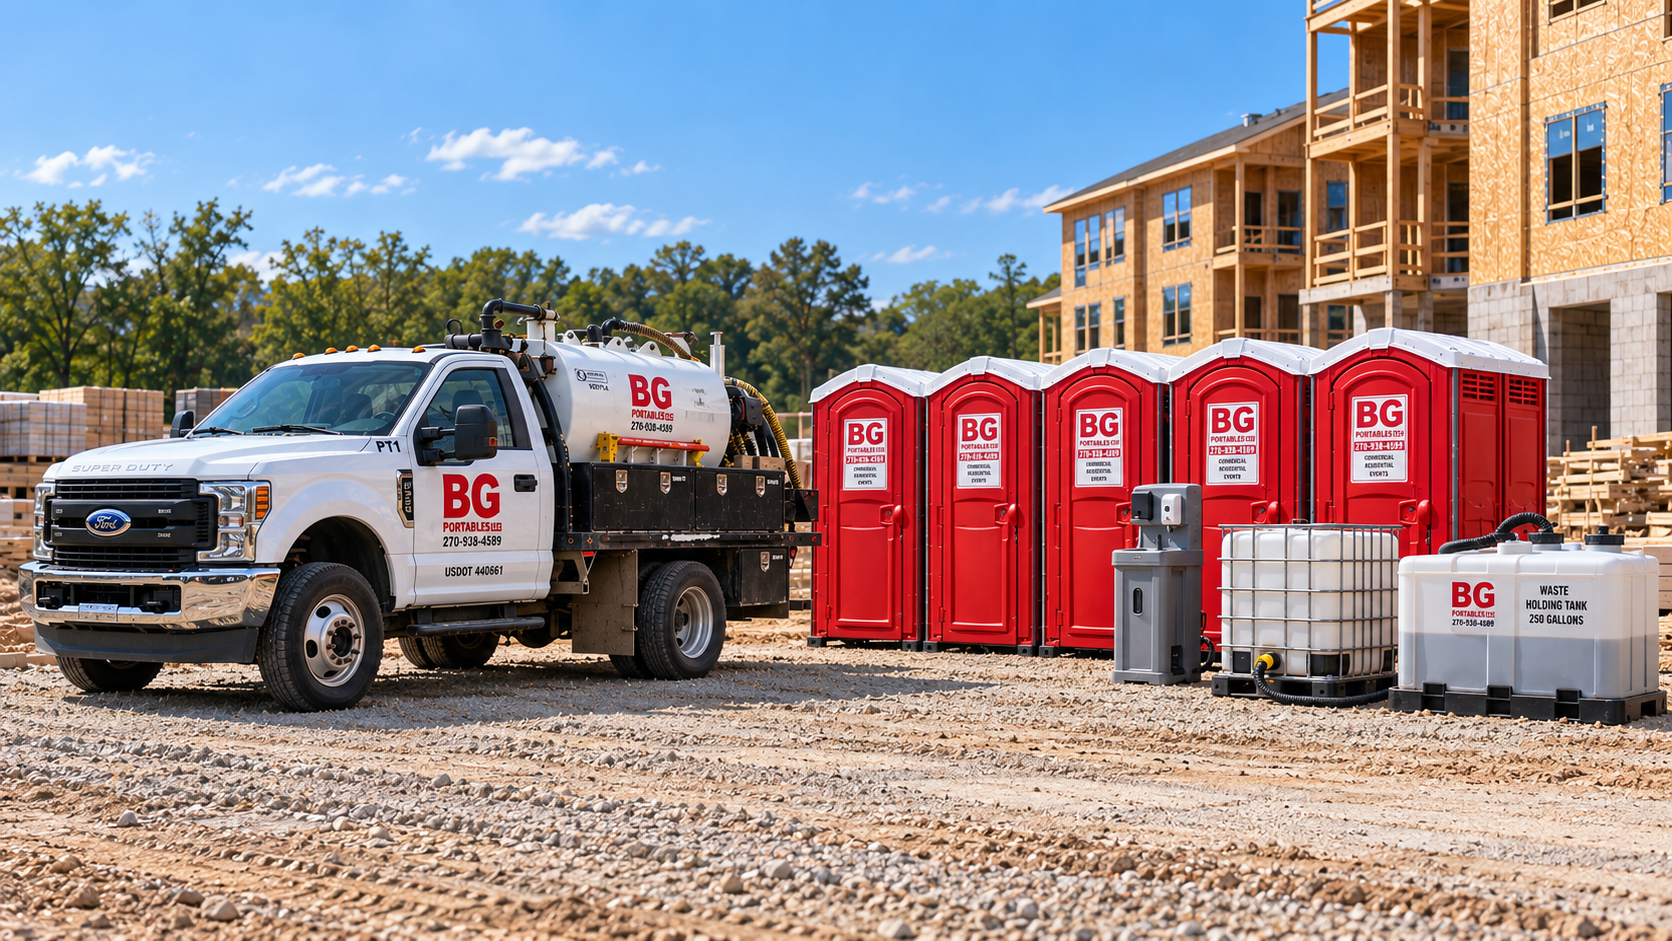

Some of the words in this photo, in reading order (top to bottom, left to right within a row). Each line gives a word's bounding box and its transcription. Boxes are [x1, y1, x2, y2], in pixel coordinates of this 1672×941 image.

[628, 374, 672, 410] BG
[1212, 406, 1255, 434] BG
[1356, 399, 1403, 428] BG
[962, 417, 998, 442] BG
[1080, 412, 1119, 438] BG
[848, 422, 884, 446] BG
[375, 440, 401, 453] PT1
[71, 464, 121, 473] SUPER
[125, 463, 174, 472] DUTY
[442, 473, 500, 519] BG
[95, 515, 118, 529] Ford
[443, 522, 490, 532] PORTABLES
[443, 536, 502, 547] 270-938-4589
[445, 566, 473, 577] USDOT
[1452, 581, 1495, 609] BG
[1540, 585, 1569, 596] WASTE
[1526, 600, 1562, 611] HOLDING
[1565, 600, 1588, 611] TANK
[1529, 614, 1545, 624] 250
[1546, 614, 1584, 625] GALLONS
